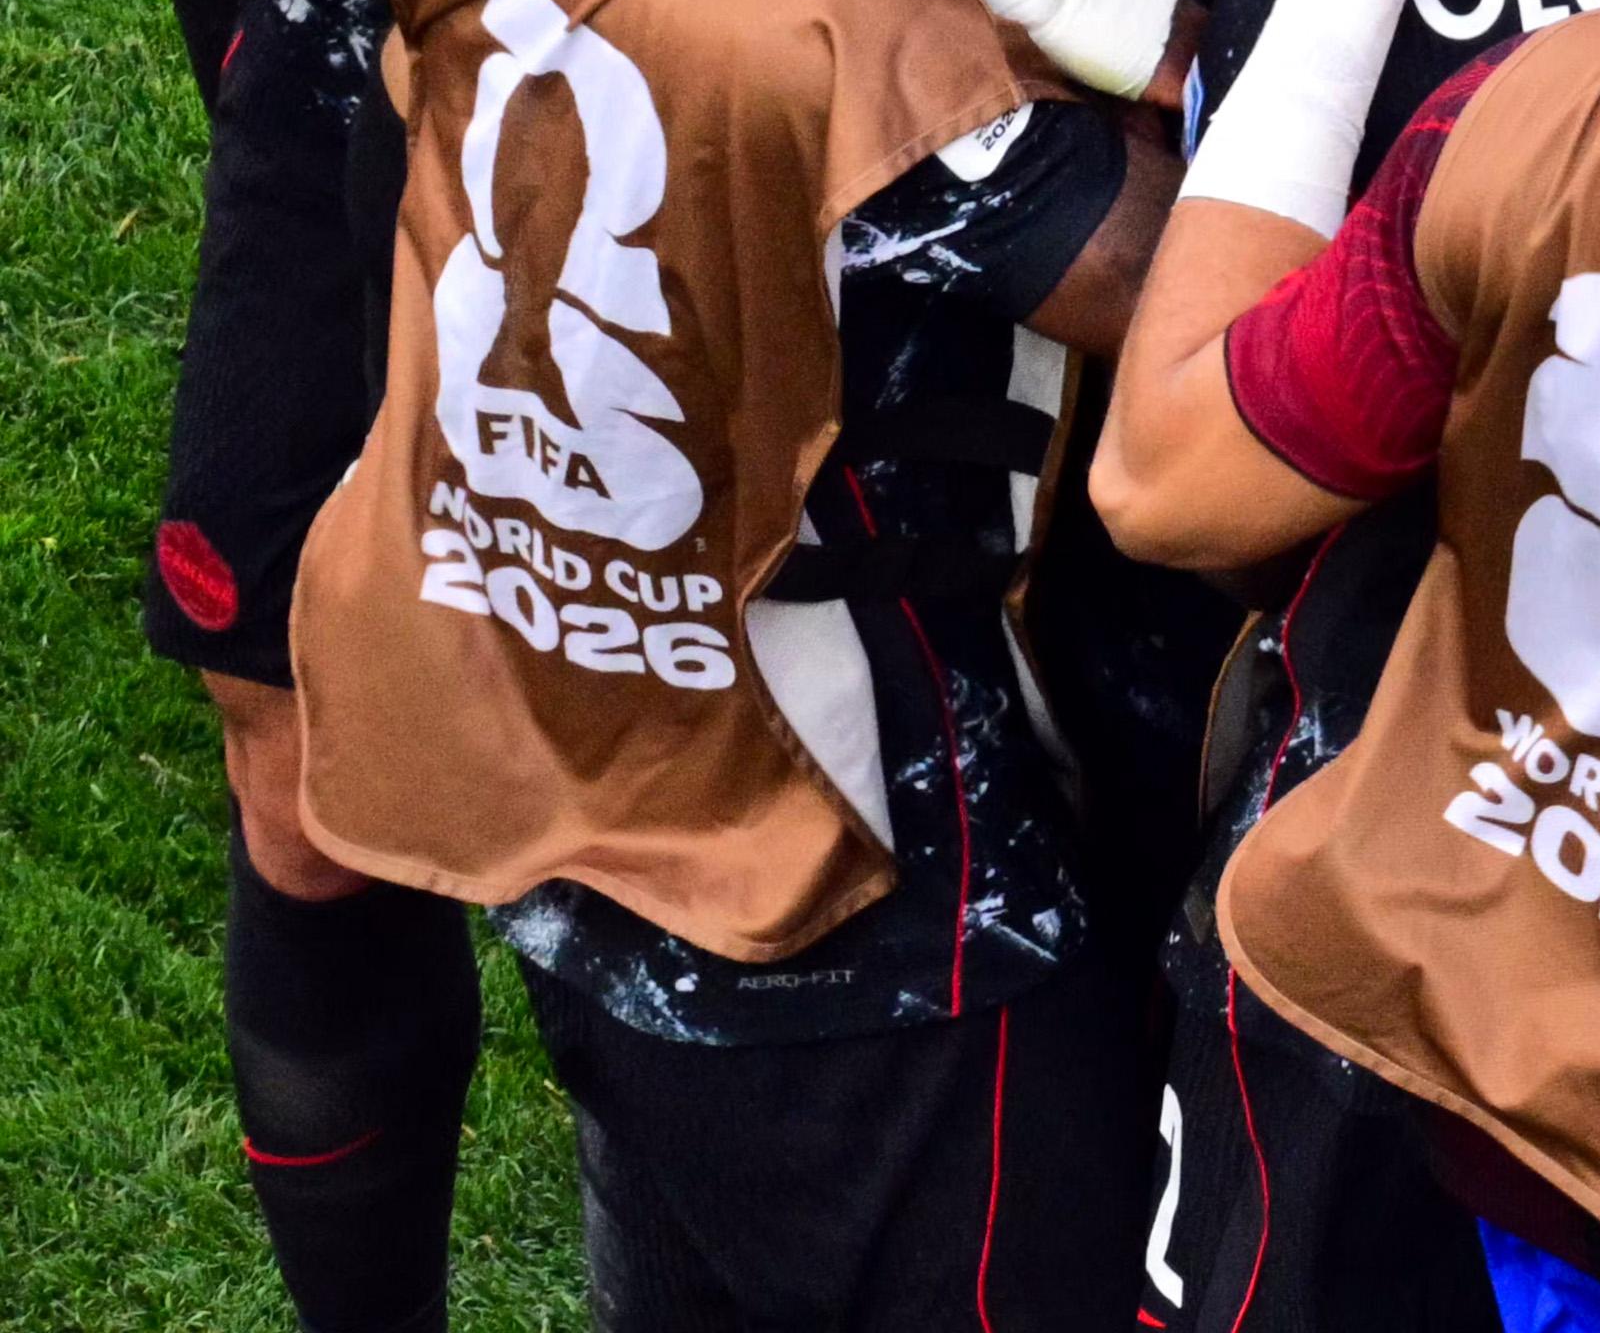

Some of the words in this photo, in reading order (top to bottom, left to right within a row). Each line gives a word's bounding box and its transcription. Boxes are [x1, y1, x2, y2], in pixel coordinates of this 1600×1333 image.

[475, 409, 613, 502] FIFA
[420, 529, 736, 690] 2026
[604, 560, 724, 613] CUP
